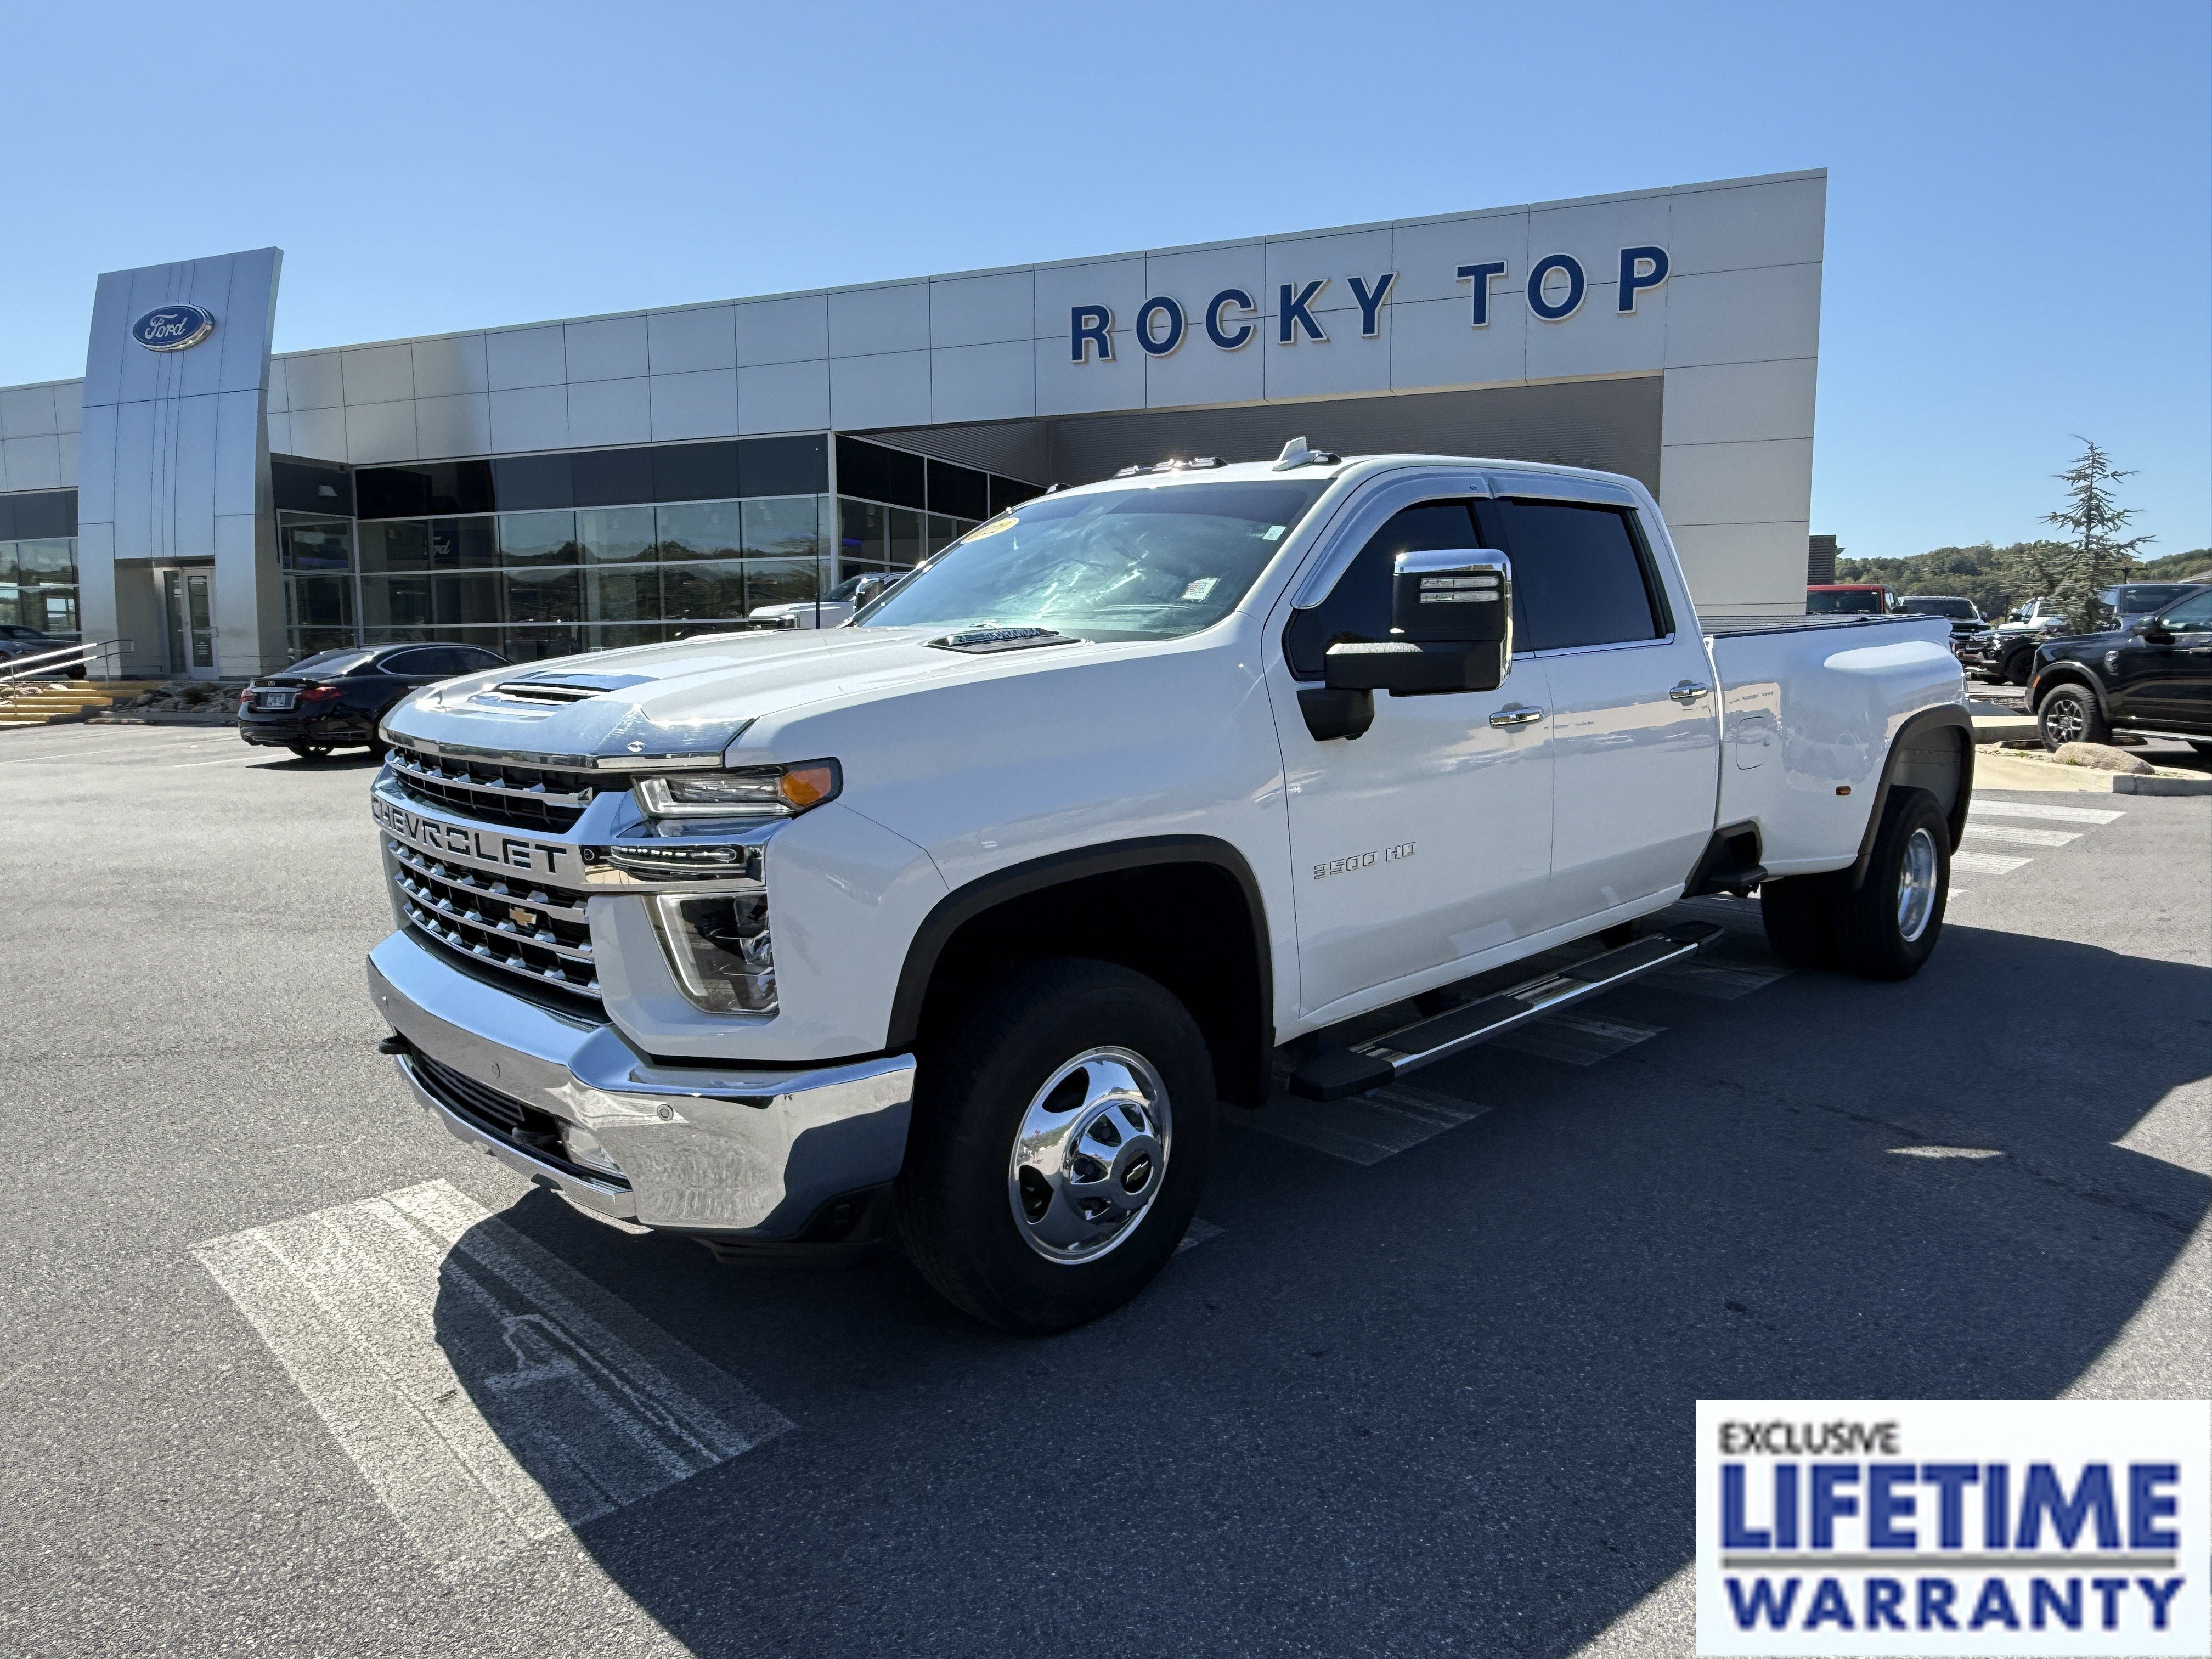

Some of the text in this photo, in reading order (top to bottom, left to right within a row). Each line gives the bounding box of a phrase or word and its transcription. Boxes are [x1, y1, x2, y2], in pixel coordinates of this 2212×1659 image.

[145, 313, 188, 339] Ford
[1071, 244, 1671, 363] ROCKY TOP
[372, 796, 567, 874] CHEVROLET
[1314, 842, 1417, 879] 3500 HD
